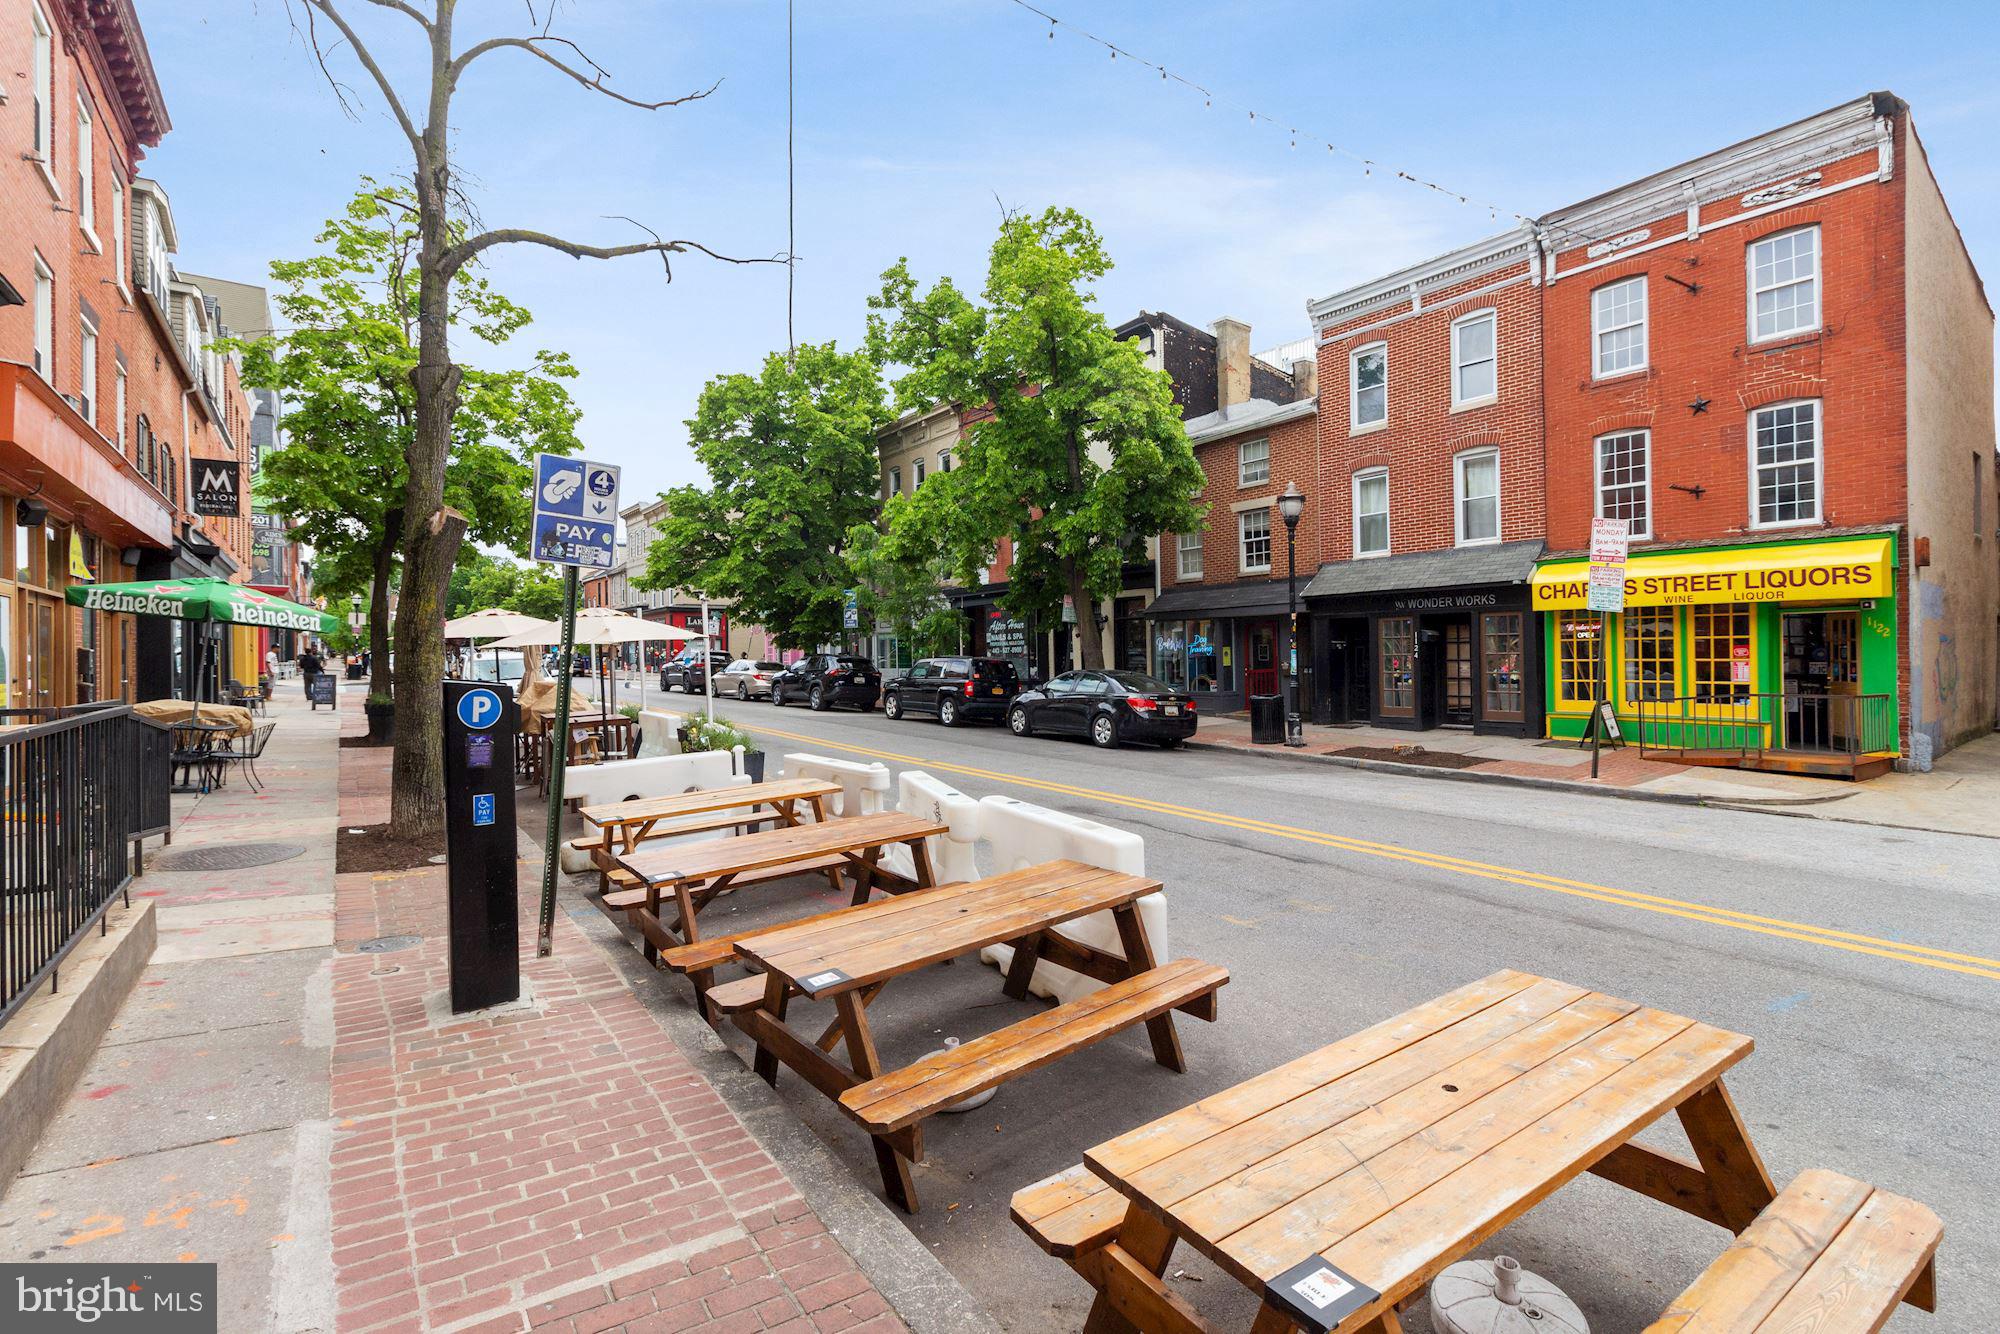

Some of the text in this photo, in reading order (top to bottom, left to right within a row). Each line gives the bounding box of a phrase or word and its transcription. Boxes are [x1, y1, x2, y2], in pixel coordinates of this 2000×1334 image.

[200, 467, 233, 492] M
[594, 472, 609, 488] 4
[197, 493, 237, 502] SALON
[556, 522, 596, 541] PAY
[1643, 573, 1737, 594] STREET
[1745, 565, 1872, 589] LIQUORS
[84, 588, 186, 618] Heineken
[1408, 597, 1453, 609] WONDER
[1455, 594, 1496, 606] WORKS
[1664, 591, 1784, 603] WINE LIQUOR
[230, 601, 322, 632] Heineken
[1867, 616, 1890, 638] 1122
[1192, 634, 1207, 646] Dog
[1188, 644, 1213, 656] Training
[472, 696, 492, 723] P
[478, 808, 490, 816] PAY
